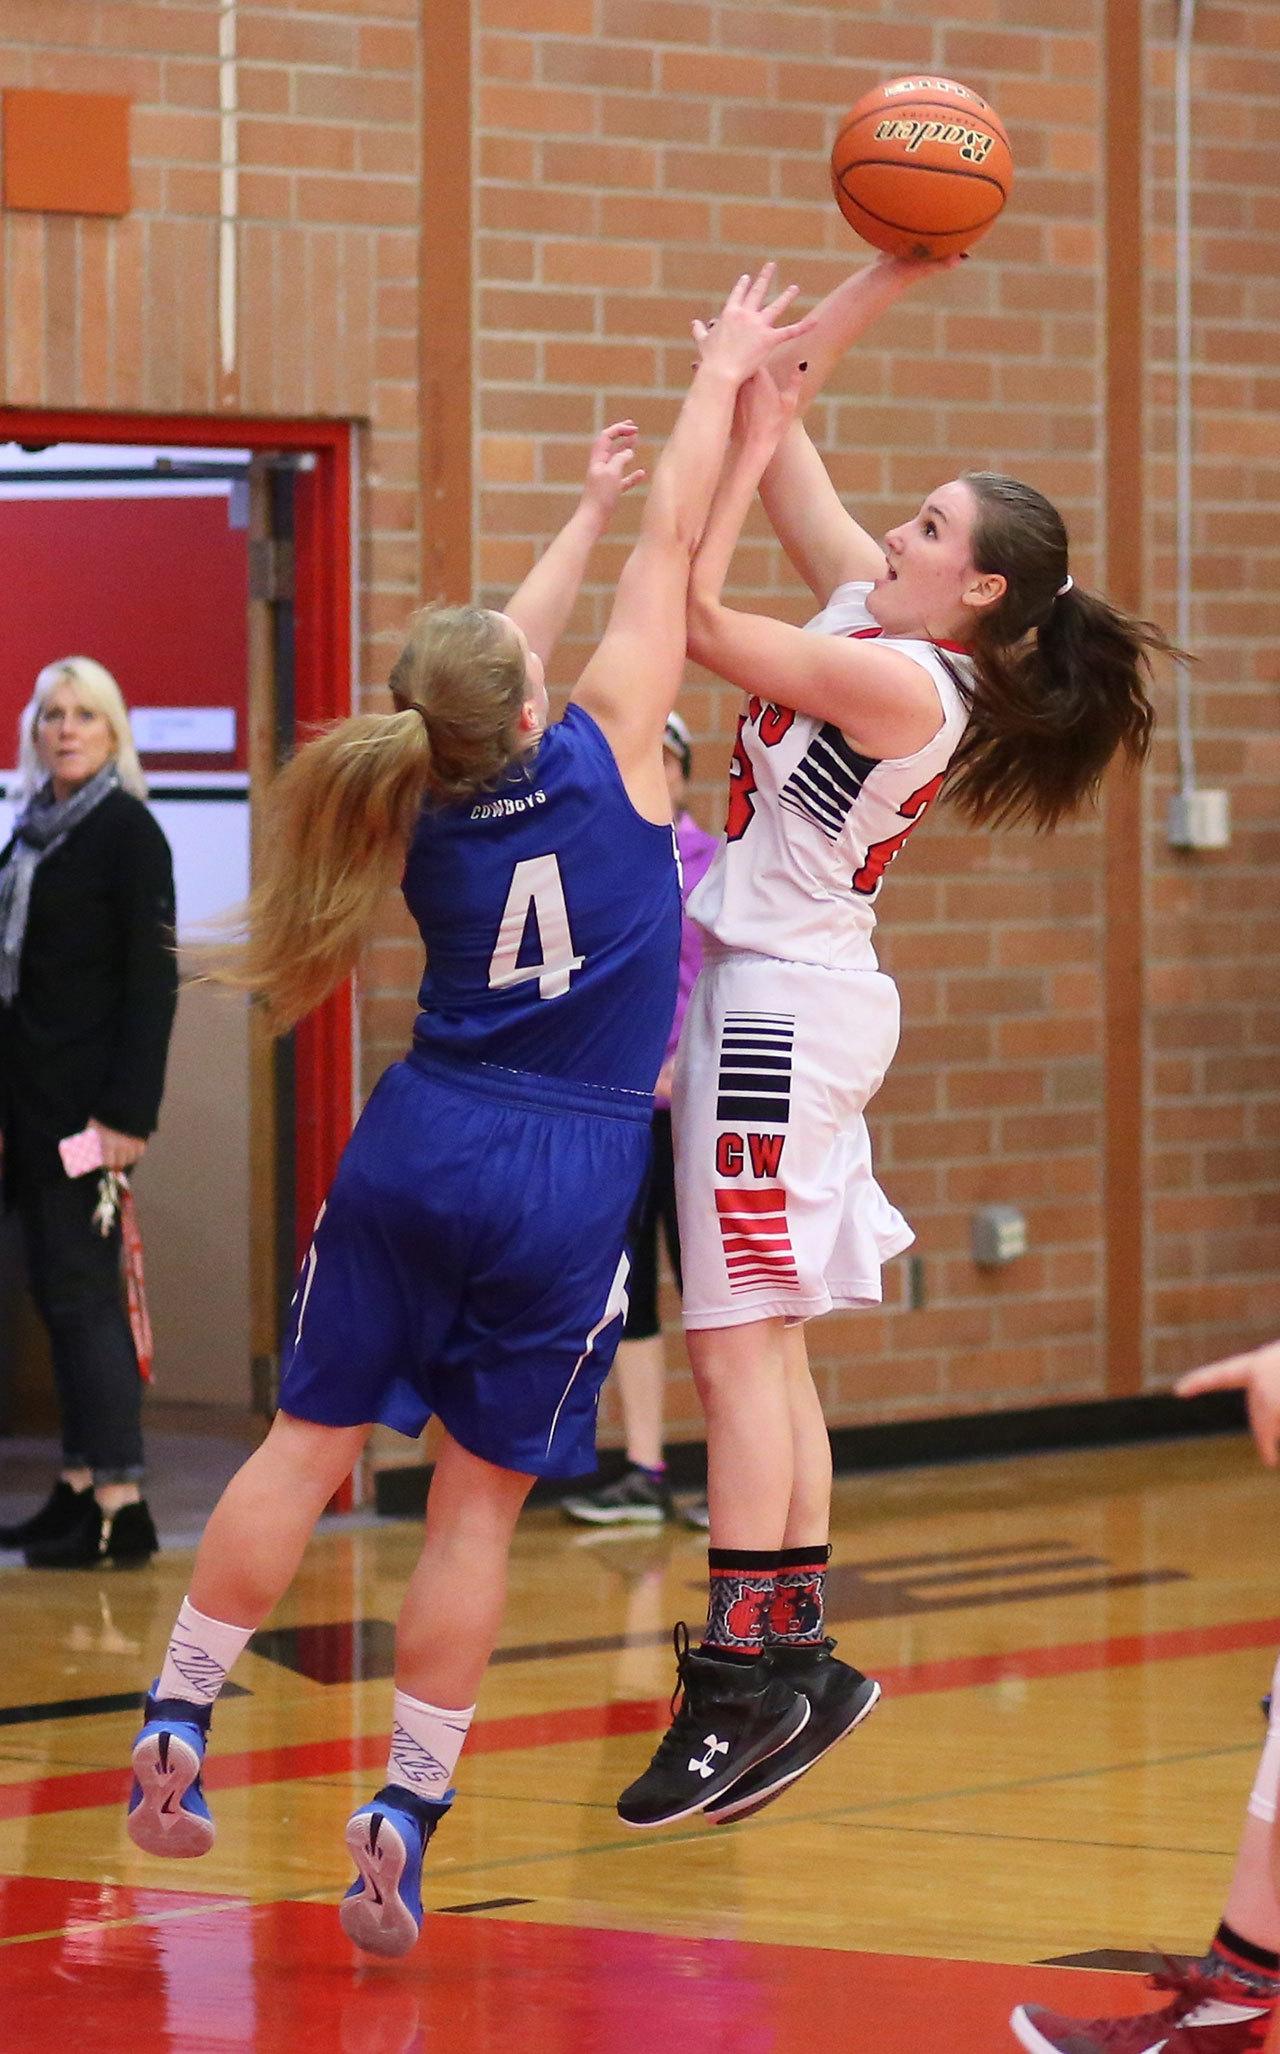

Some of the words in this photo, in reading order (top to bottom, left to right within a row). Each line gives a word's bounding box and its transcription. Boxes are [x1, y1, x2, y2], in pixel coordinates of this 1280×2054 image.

[874, 120, 995, 164] Baden
[470, 789, 547, 820] COWBOYS
[488, 853, 586, 1000] 4
[716, 1132, 786, 1178] CW
